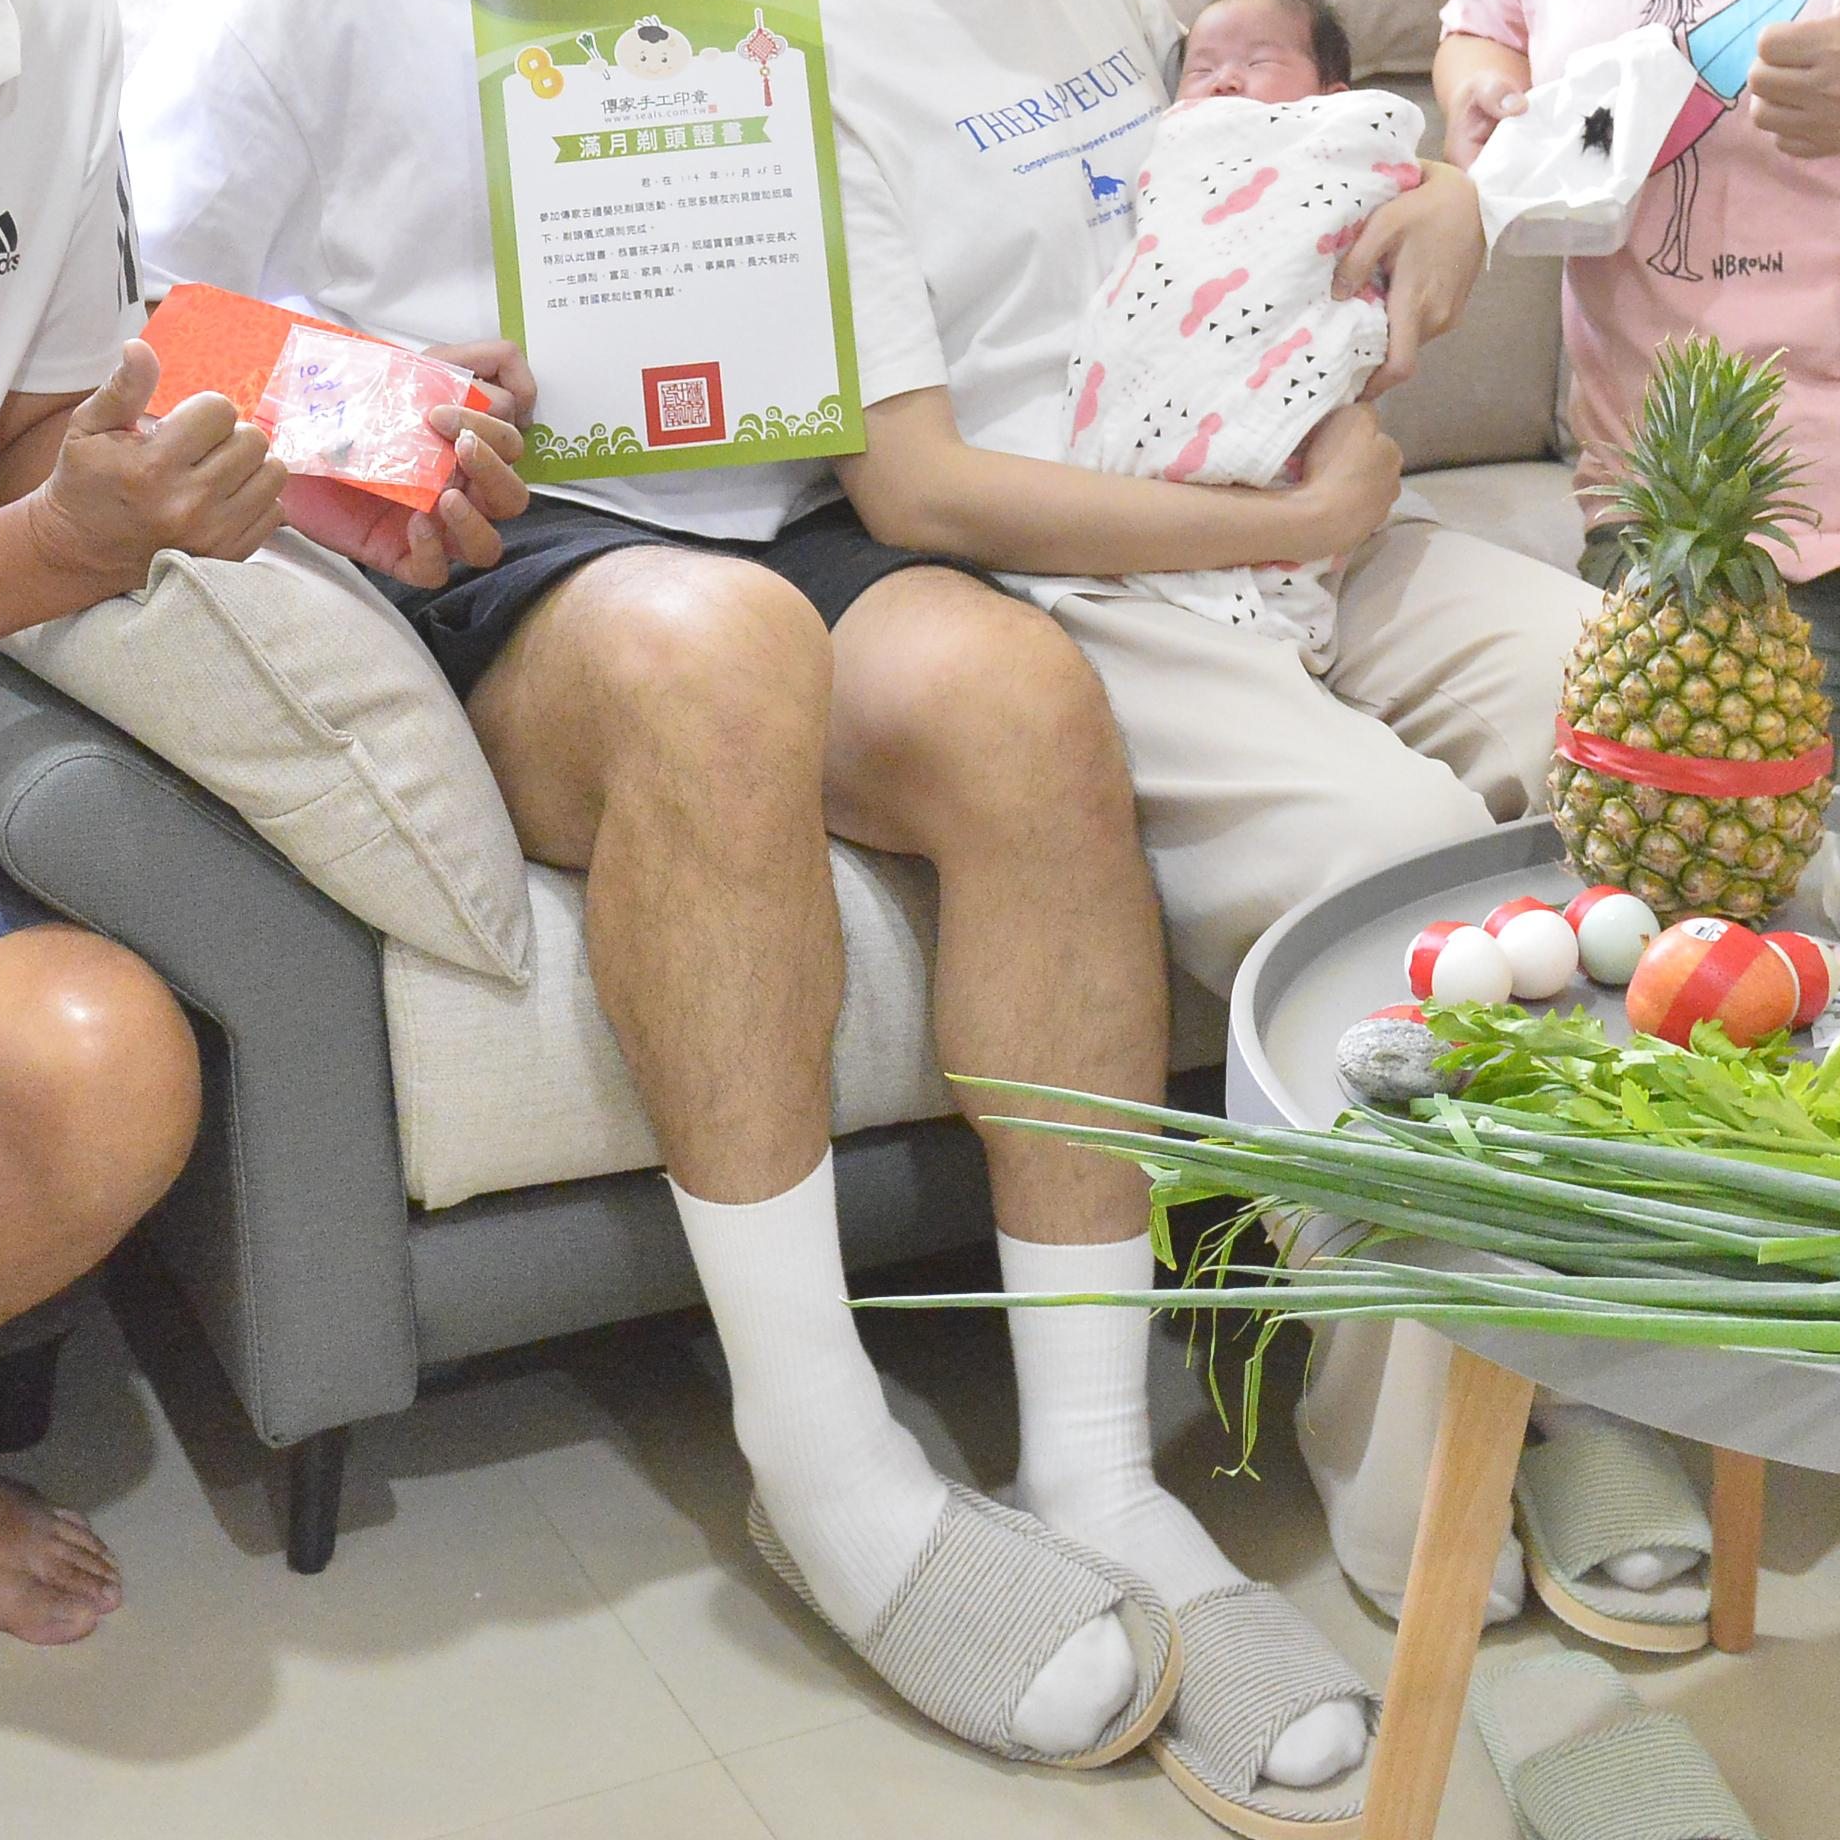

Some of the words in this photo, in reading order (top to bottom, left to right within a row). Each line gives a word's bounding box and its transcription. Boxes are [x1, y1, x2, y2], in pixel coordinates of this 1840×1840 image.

[601, 89, 709, 114] 傳家手工印章
[578, 121, 744, 159] 滿月剃頭證書
[1712, 251, 1783, 281] HBROWN
